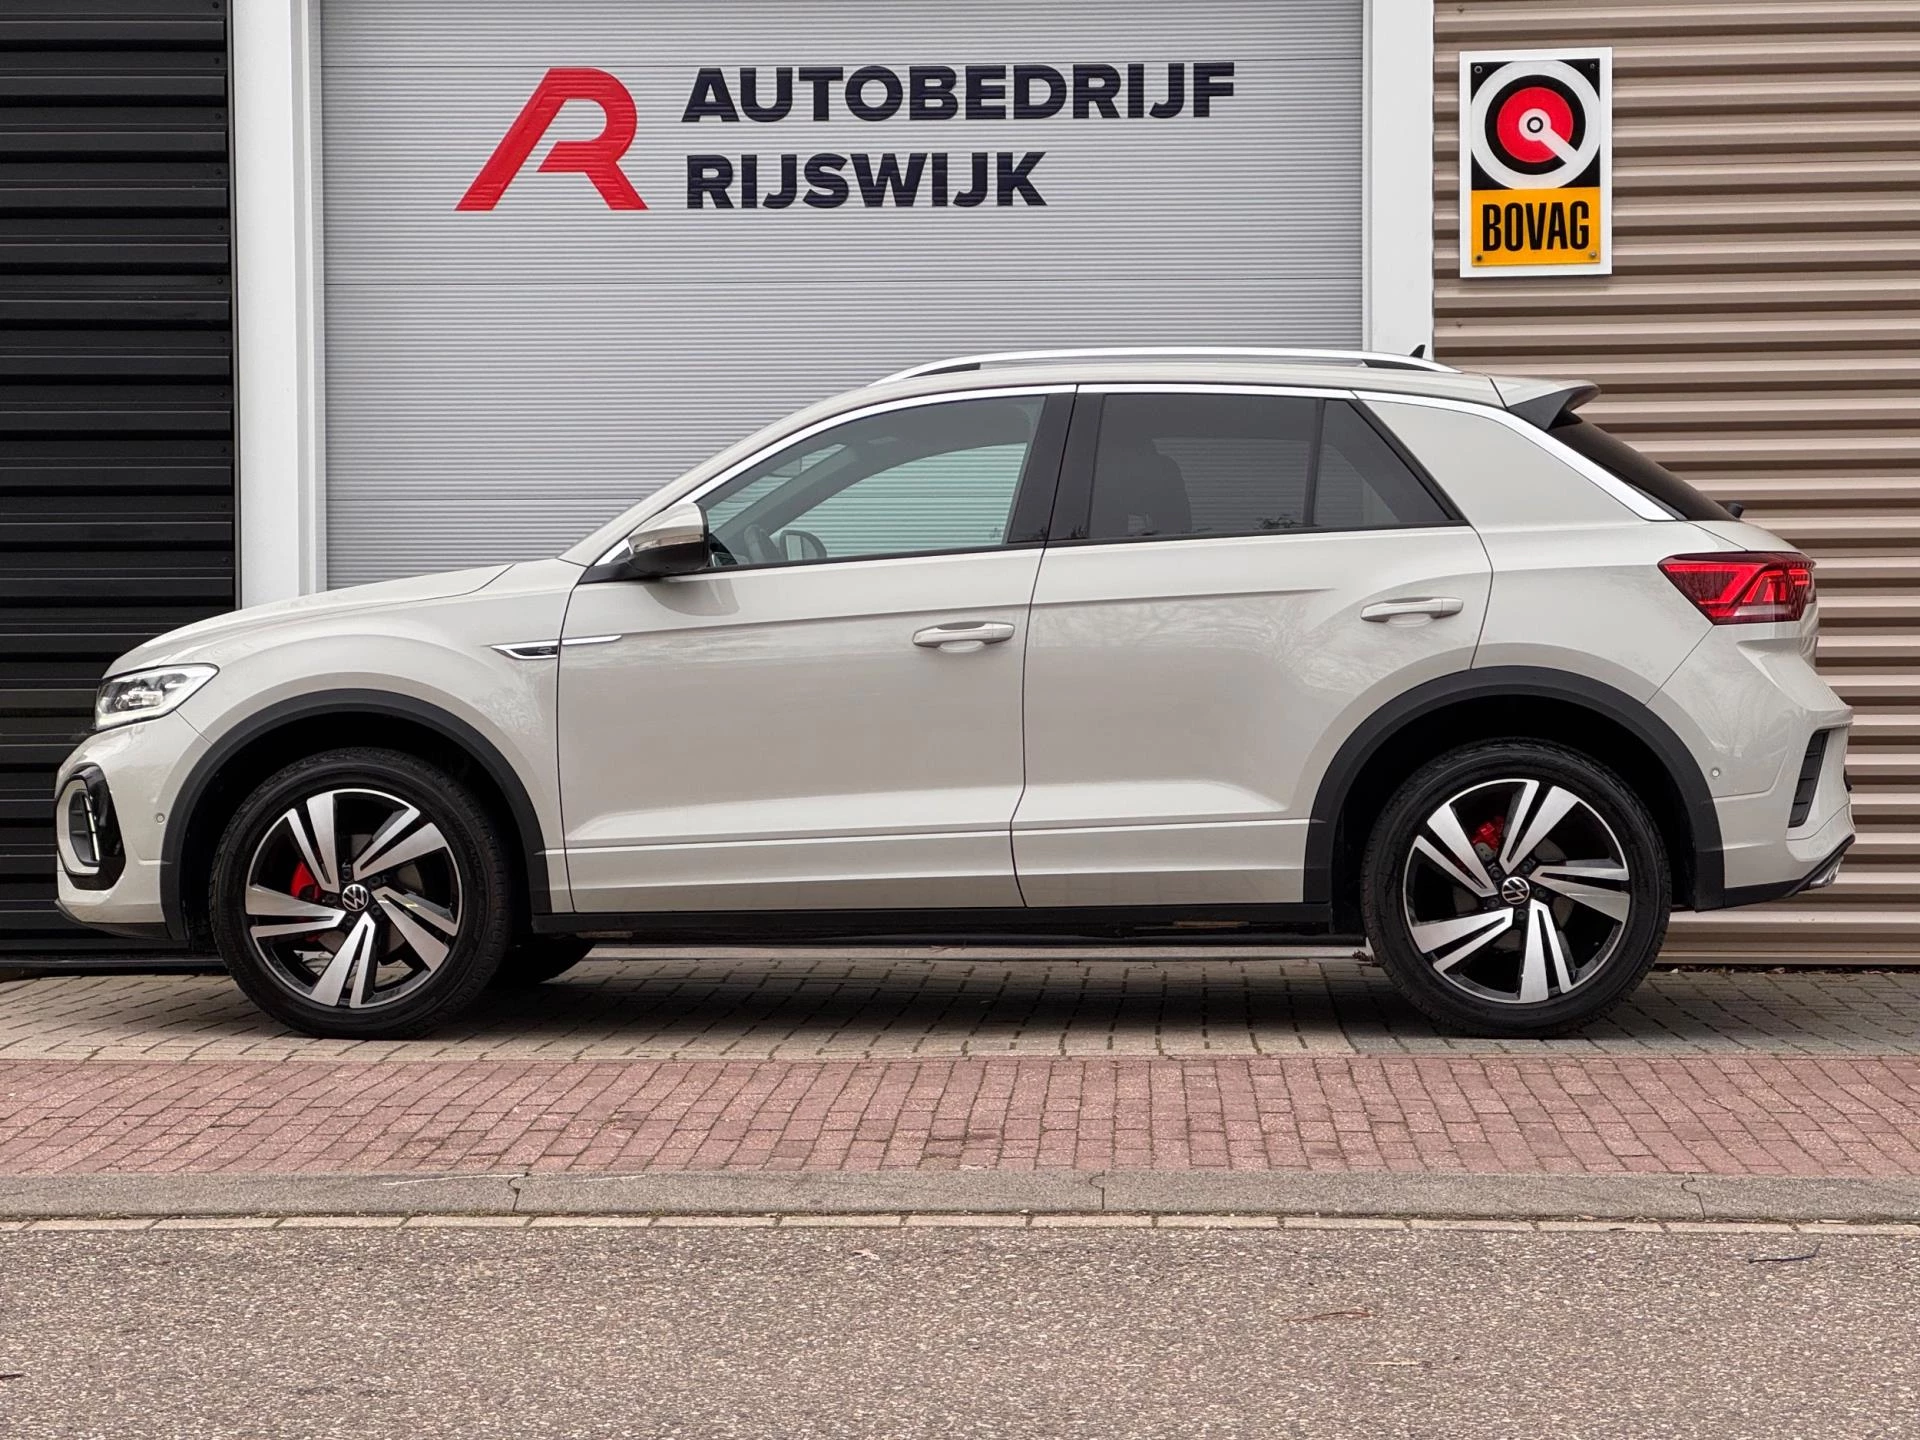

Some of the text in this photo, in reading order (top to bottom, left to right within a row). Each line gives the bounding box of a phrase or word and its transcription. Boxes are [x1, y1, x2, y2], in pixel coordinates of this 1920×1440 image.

[681, 61, 1236, 123] AUTOBEDRIJF
[686, 151, 1047, 210] RIJSWIJK
[1482, 200, 1590, 252] BOVAG
